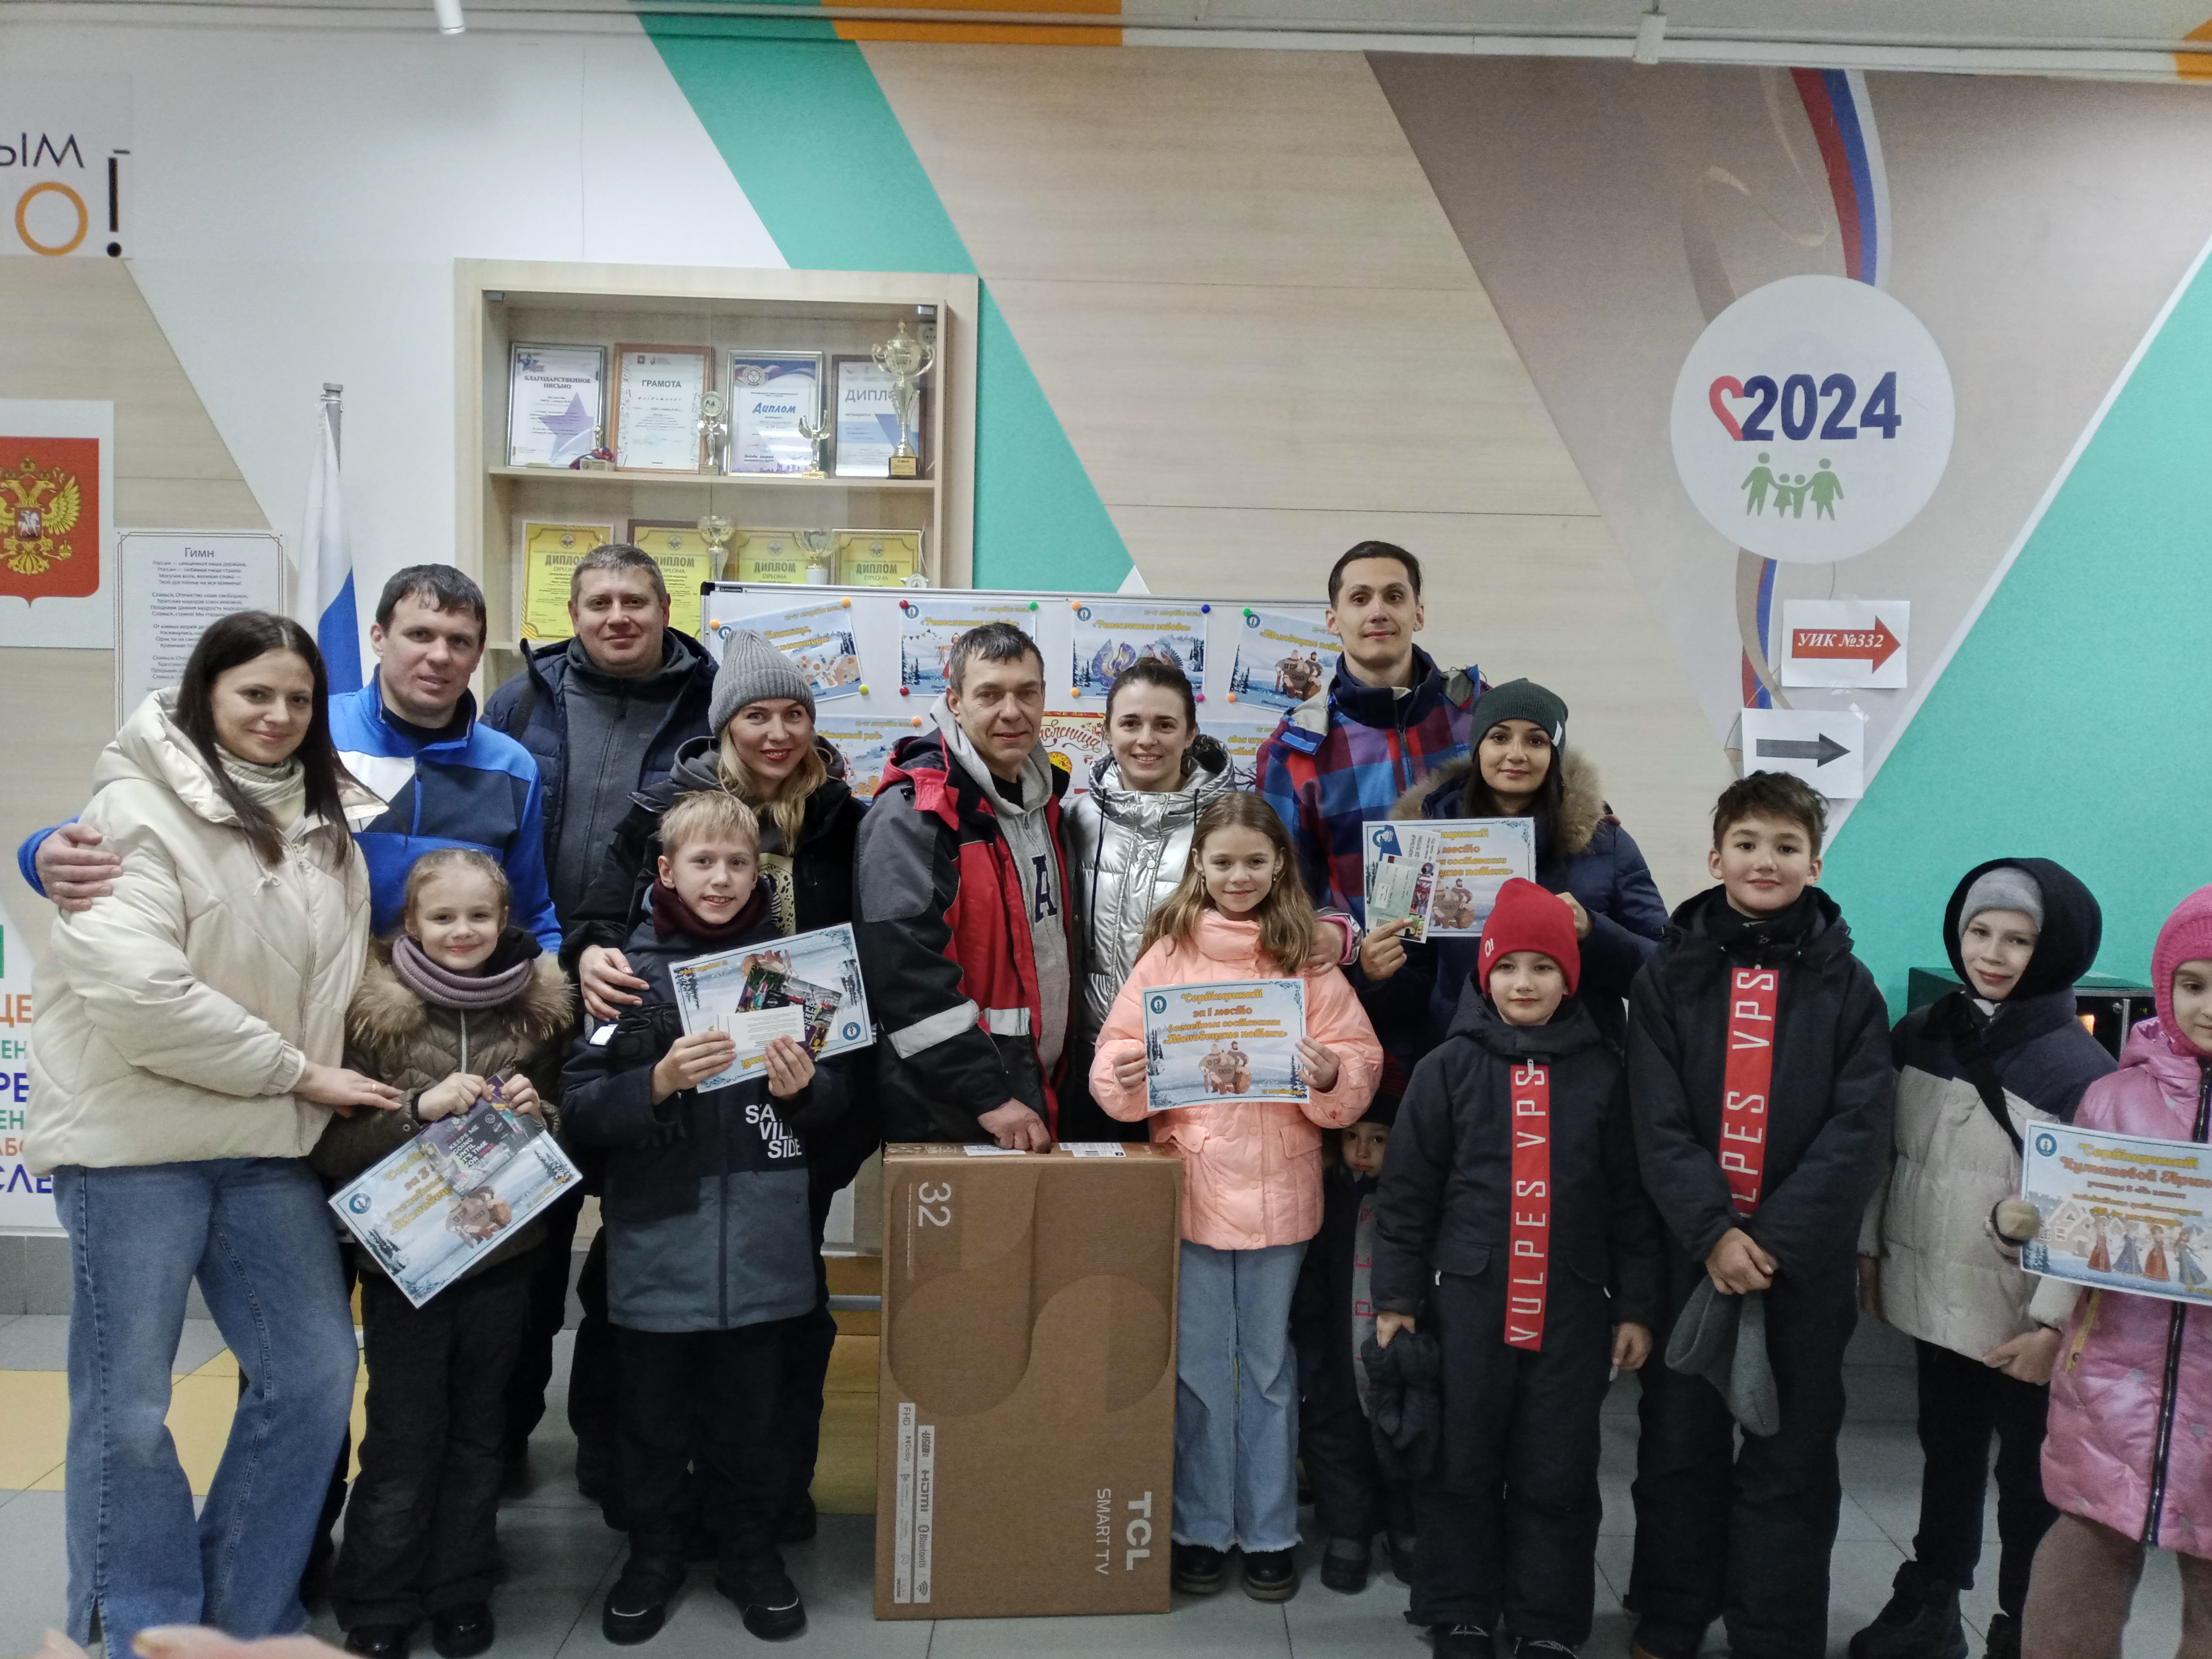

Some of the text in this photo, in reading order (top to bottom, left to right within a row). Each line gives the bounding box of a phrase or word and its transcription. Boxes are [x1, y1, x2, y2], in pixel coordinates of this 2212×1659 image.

[845, 390, 892, 403] ДИПЛО
[1742, 372, 1902, 441] 2024
[752, 402, 796, 414] Диплом
[185, 548, 214, 557] Гимн
[545, 555, 580, 566] ДИПЛО
[754, 562, 795, 573] ДИПЛОМ
[856, 563, 897, 574] ДИПЛОМ
[1797, 633, 1884, 648] УИК №332
[1442, 844, 1480, 853] место
[1032, 853, 1057, 923] A
[1180, 988, 1263, 1003] Сертификат
[1193, 1009, 1205, 1018] за
[1214, 1005, 1253, 1016] место
[1732, 971, 1774, 1049] VPS
[1174, 1020, 1221, 1031] семейном
[1221, 1018, 1281, 1027] состязании
[1163, 1028, 1288, 1044] «Молодецкие потехи»
[1515, 1070, 1546, 1148] VPS
[448, 1133, 469, 1150] KEEPS
[468, 1124, 480, 1135] ME
[454, 1137, 473, 1154] GOING
[471, 1140, 489, 1154] TIME
[767, 1138, 802, 1159] SIDE
[1721, 1091, 1765, 1218] LPES
[2078, 1143, 2199, 1169] Сертификат
[418, 1166, 430, 1180] 3
[389, 1184, 453, 1236] «Молодец
[917, 1182, 952, 1227] 32
[1509, 1180, 1547, 1342] VULPES
[902, 1406, 911, 1426] FHD
[920, 1469, 930, 1512] HDMI
[1094, 1487, 1111, 1575] SMART TV
[1125, 1491, 1152, 1571] TCL
[918, 1534, 928, 1568] Bluetooth
